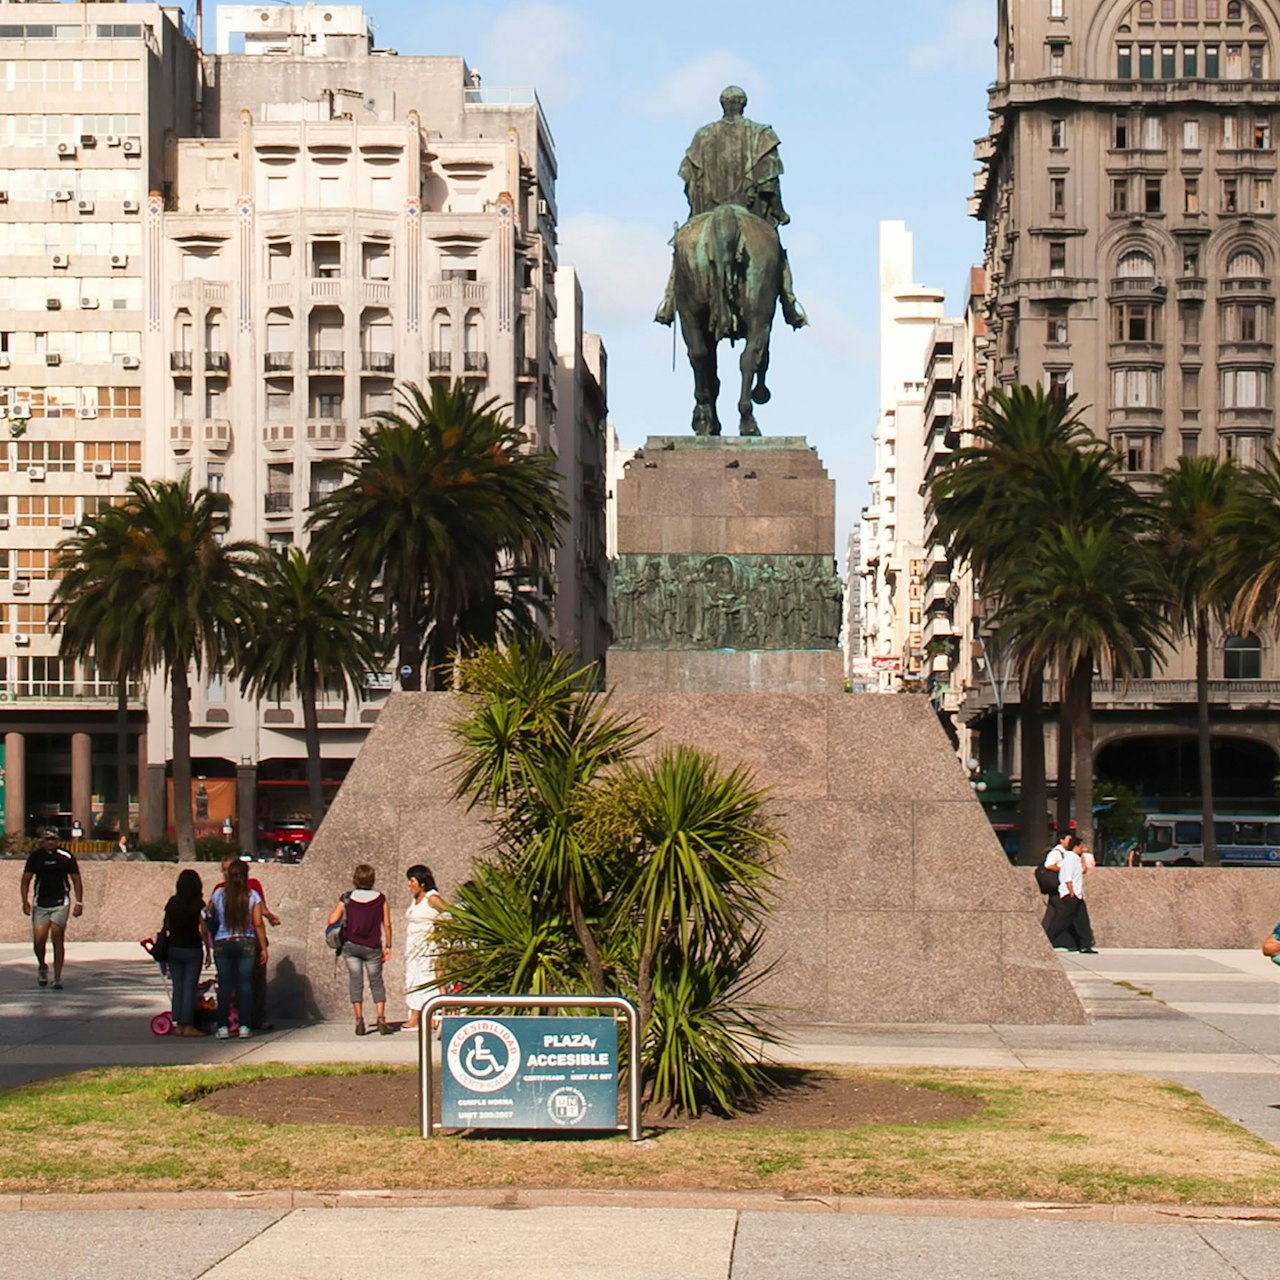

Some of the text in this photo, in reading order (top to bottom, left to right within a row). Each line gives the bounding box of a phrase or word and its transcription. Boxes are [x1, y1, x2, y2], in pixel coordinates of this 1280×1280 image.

[910, 559, 921, 672] HOTEL
[450, 1022, 518, 1056] ACCESIBILIDAD
[543, 1034, 591, 1048] PLAZA
[526, 1052, 609, 1067] ACCESIBLE
[458, 1072, 511, 1092] CERTIFICADA
[588, 1073, 599, 1081] AC
[458, 1111, 478, 1119] UNIT
